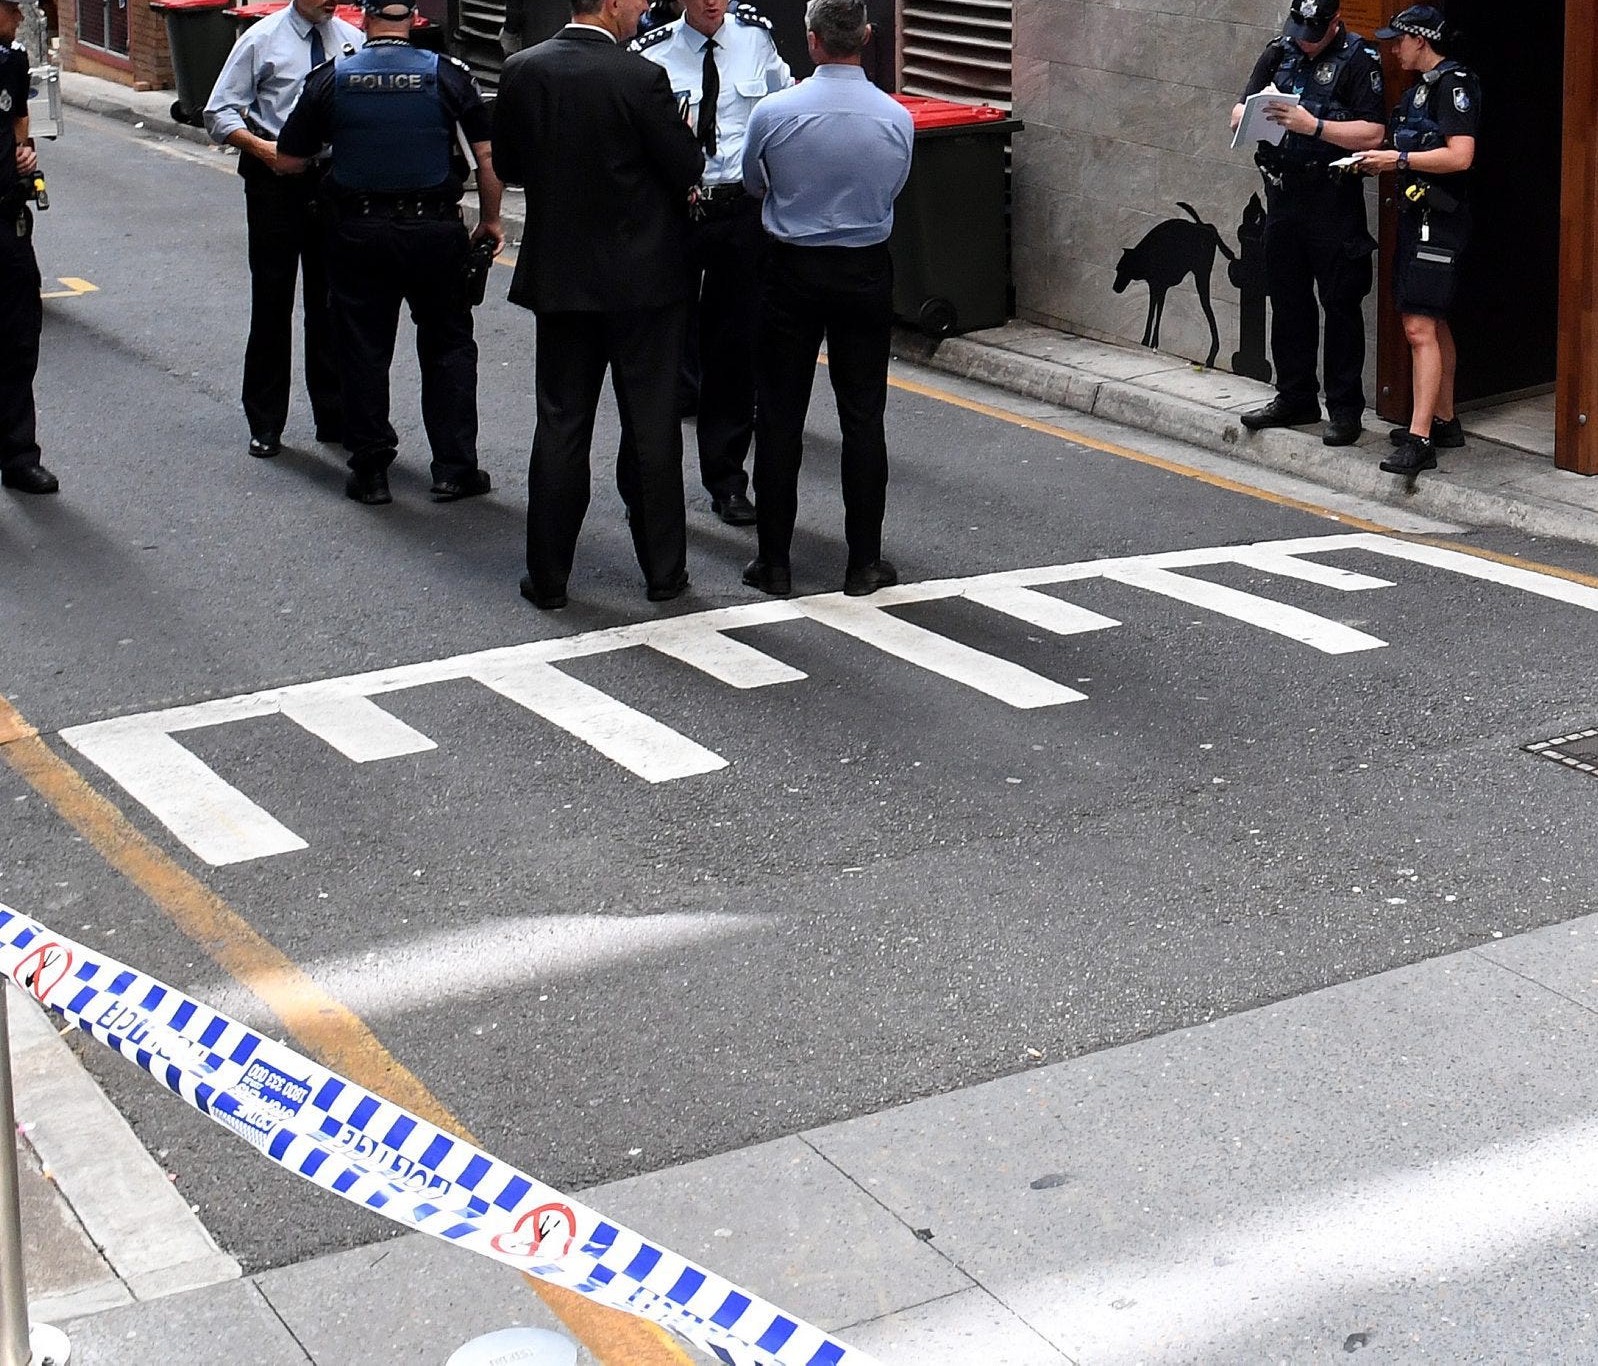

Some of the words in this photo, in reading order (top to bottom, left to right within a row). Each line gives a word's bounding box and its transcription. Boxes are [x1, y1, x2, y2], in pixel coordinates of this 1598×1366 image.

[349, 74, 422, 89] POLICE
[247, 1063, 270, 1083] 000
[264, 1072, 287, 1092] 333
[281, 1081, 309, 1103] 1800
